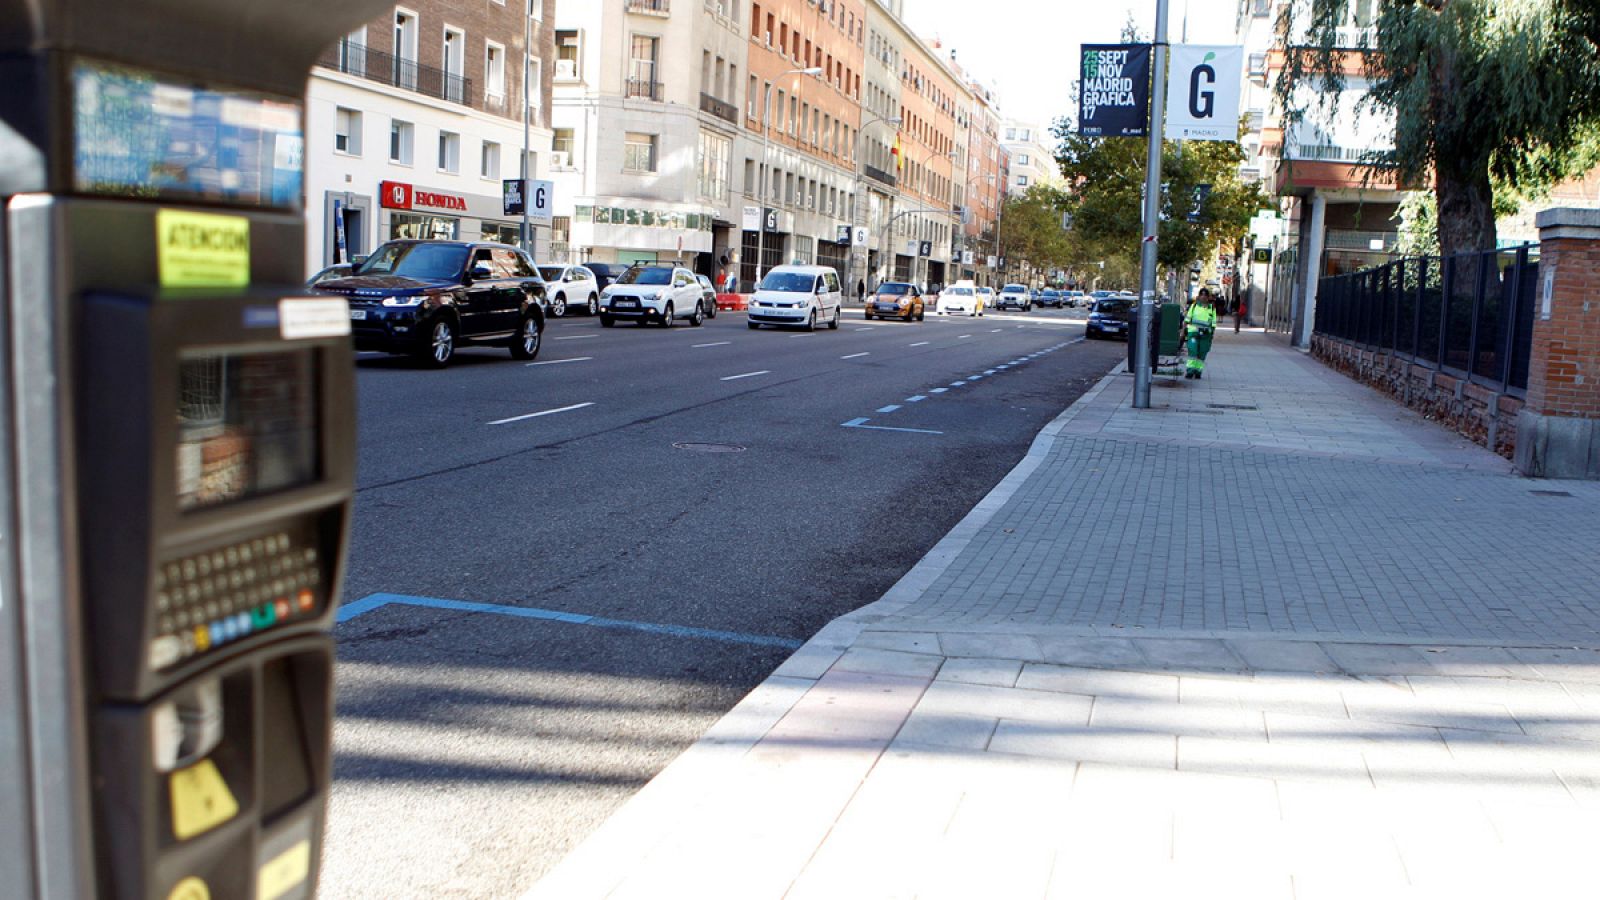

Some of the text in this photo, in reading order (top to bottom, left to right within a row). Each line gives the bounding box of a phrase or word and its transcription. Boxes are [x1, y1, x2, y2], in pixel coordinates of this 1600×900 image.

[1083, 78, 1133, 92] MADRID
[1083, 91, 1136, 106] GRAFICA
[1082, 105, 1097, 120] 17
[1191, 129, 1219, 137] MADRID
[415, 191, 468, 211] HONDA
[535, 187, 545, 209] G
